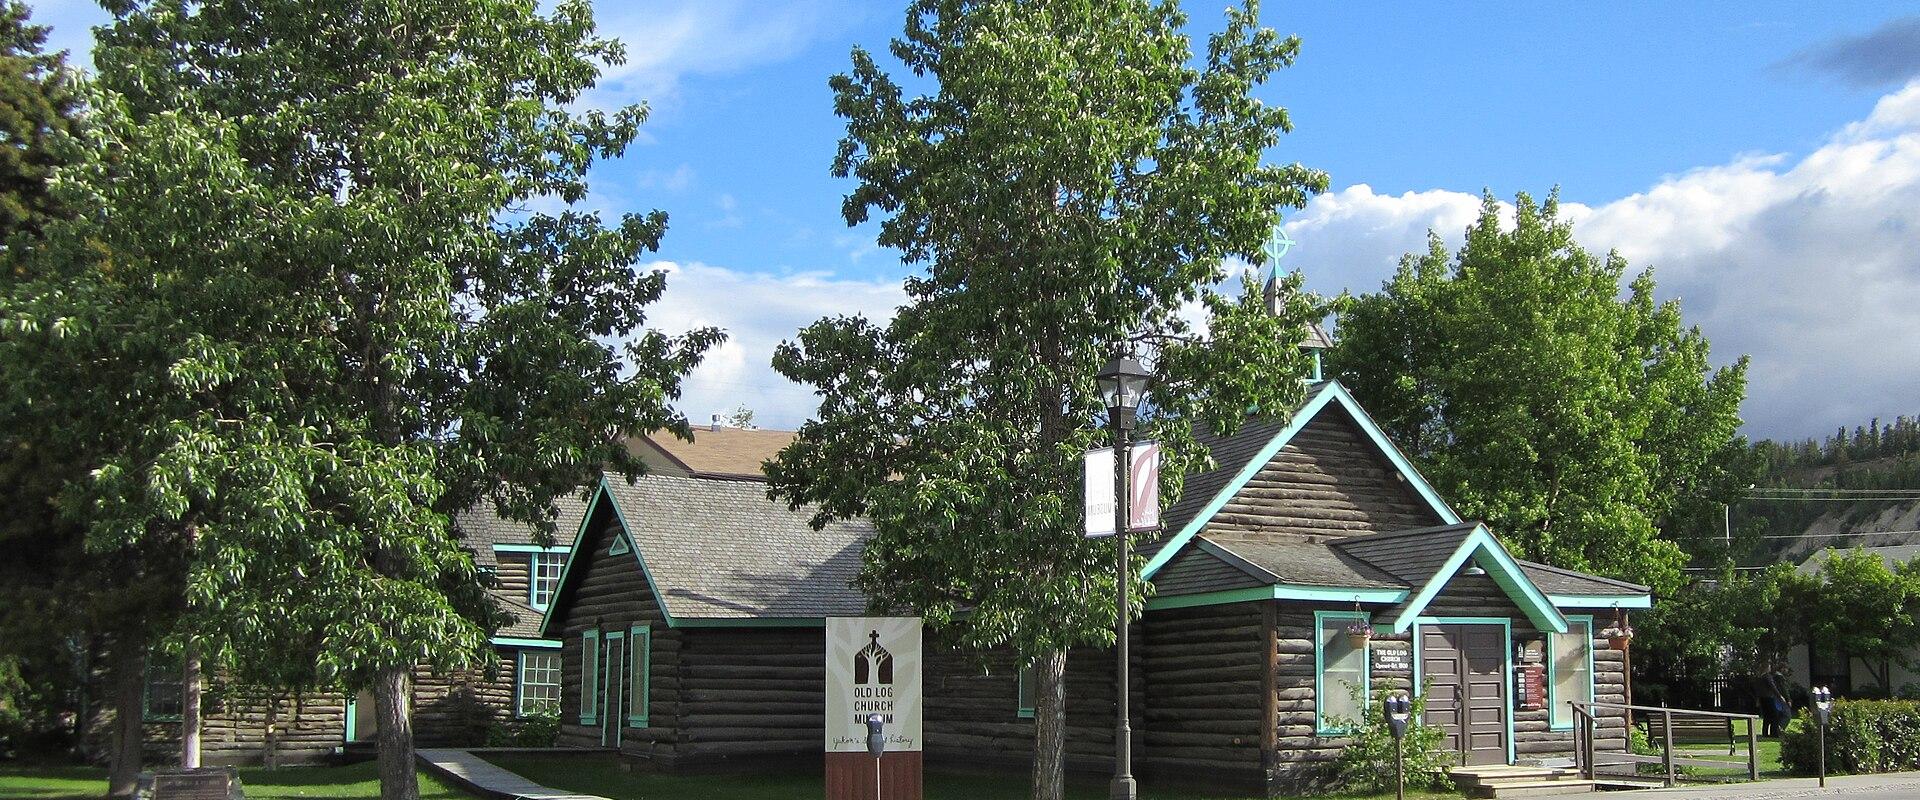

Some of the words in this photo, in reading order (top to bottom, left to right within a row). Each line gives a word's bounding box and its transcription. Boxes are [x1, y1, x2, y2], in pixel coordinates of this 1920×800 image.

[854, 687, 872, 698] OLD
[875, 687, 893, 698] LOG
[854, 700, 893, 711] CHURCH
